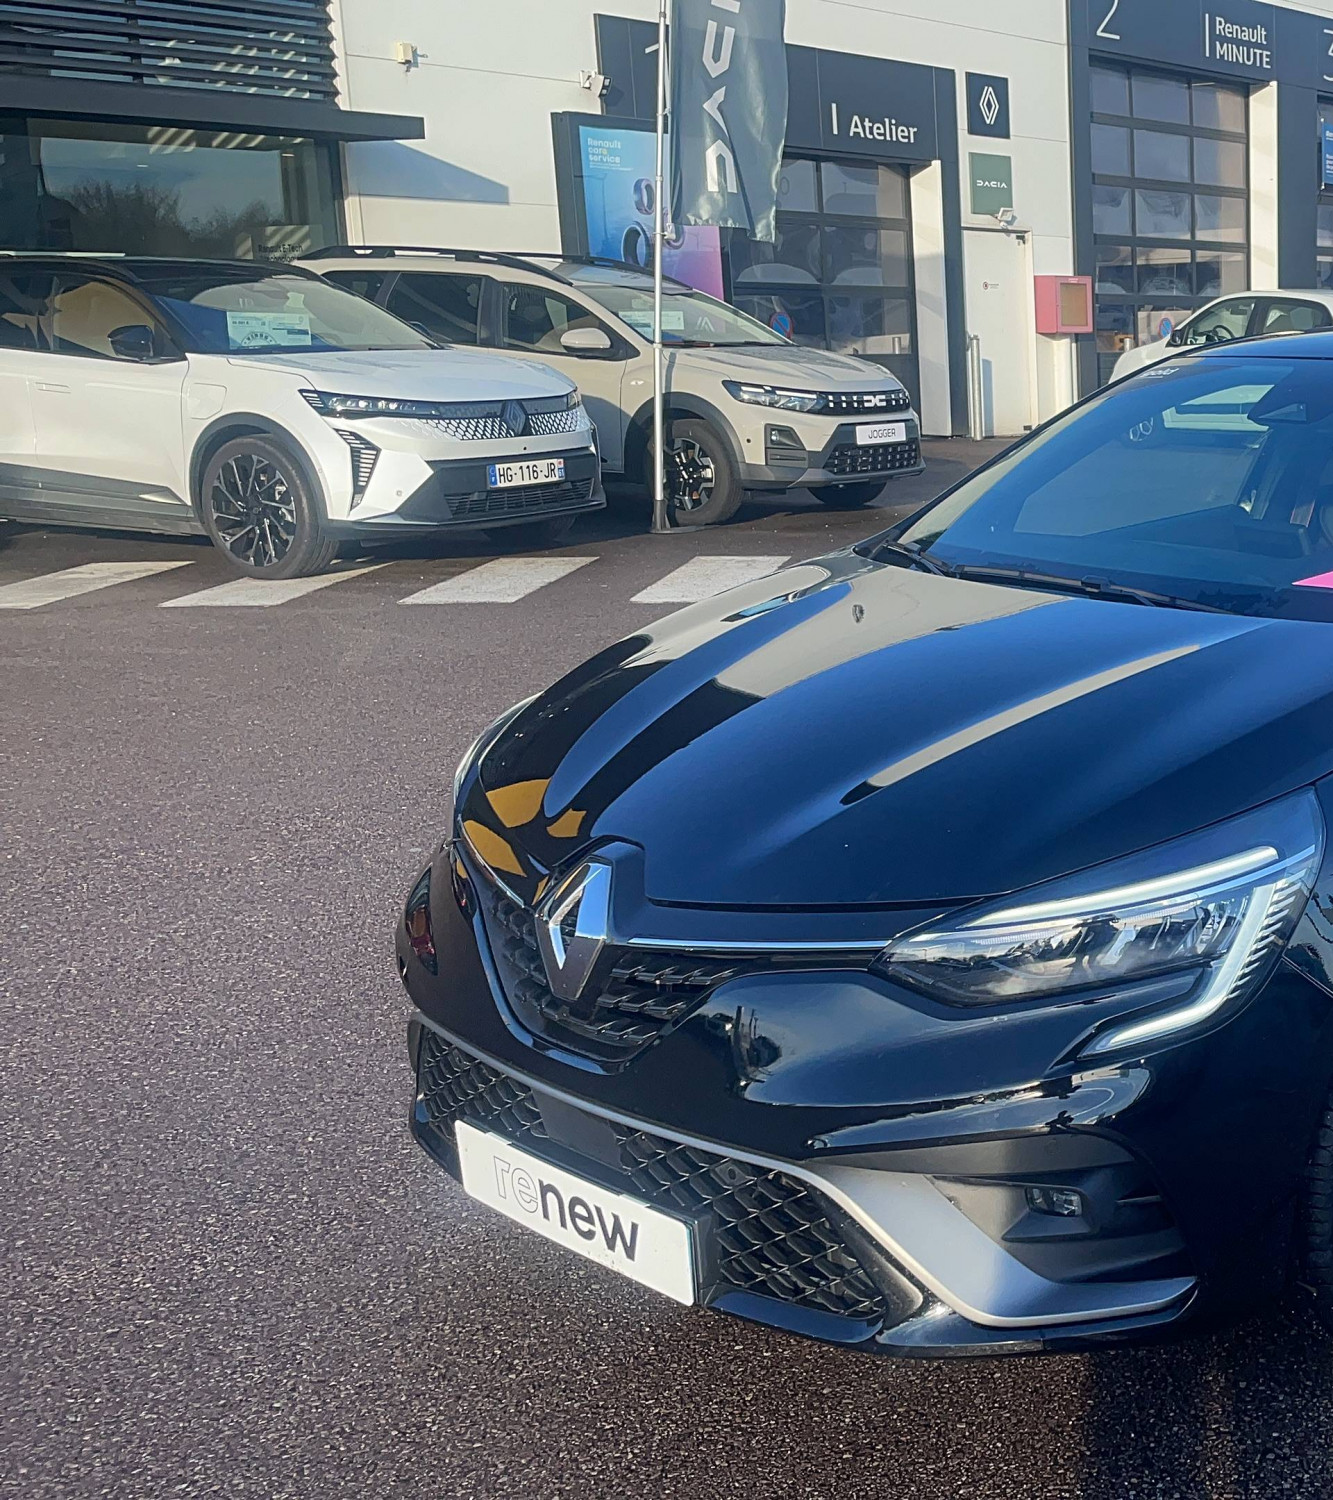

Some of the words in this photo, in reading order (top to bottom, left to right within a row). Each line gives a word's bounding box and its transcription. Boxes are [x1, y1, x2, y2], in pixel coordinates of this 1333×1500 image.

[1215, 16, 1267, 45] Renault
[1215, 41, 1272, 69] MINUTE
[849, 114, 918, 143] Atelier
[587, 137, 621, 149] Renault
[588, 154, 621, 164] service
[976, 179, 1008, 189] DACIA
[867, 427, 896, 440] JOGGER
[498, 462, 557, 484] HG-116-JR
[493, 1155, 640, 1263] renew
